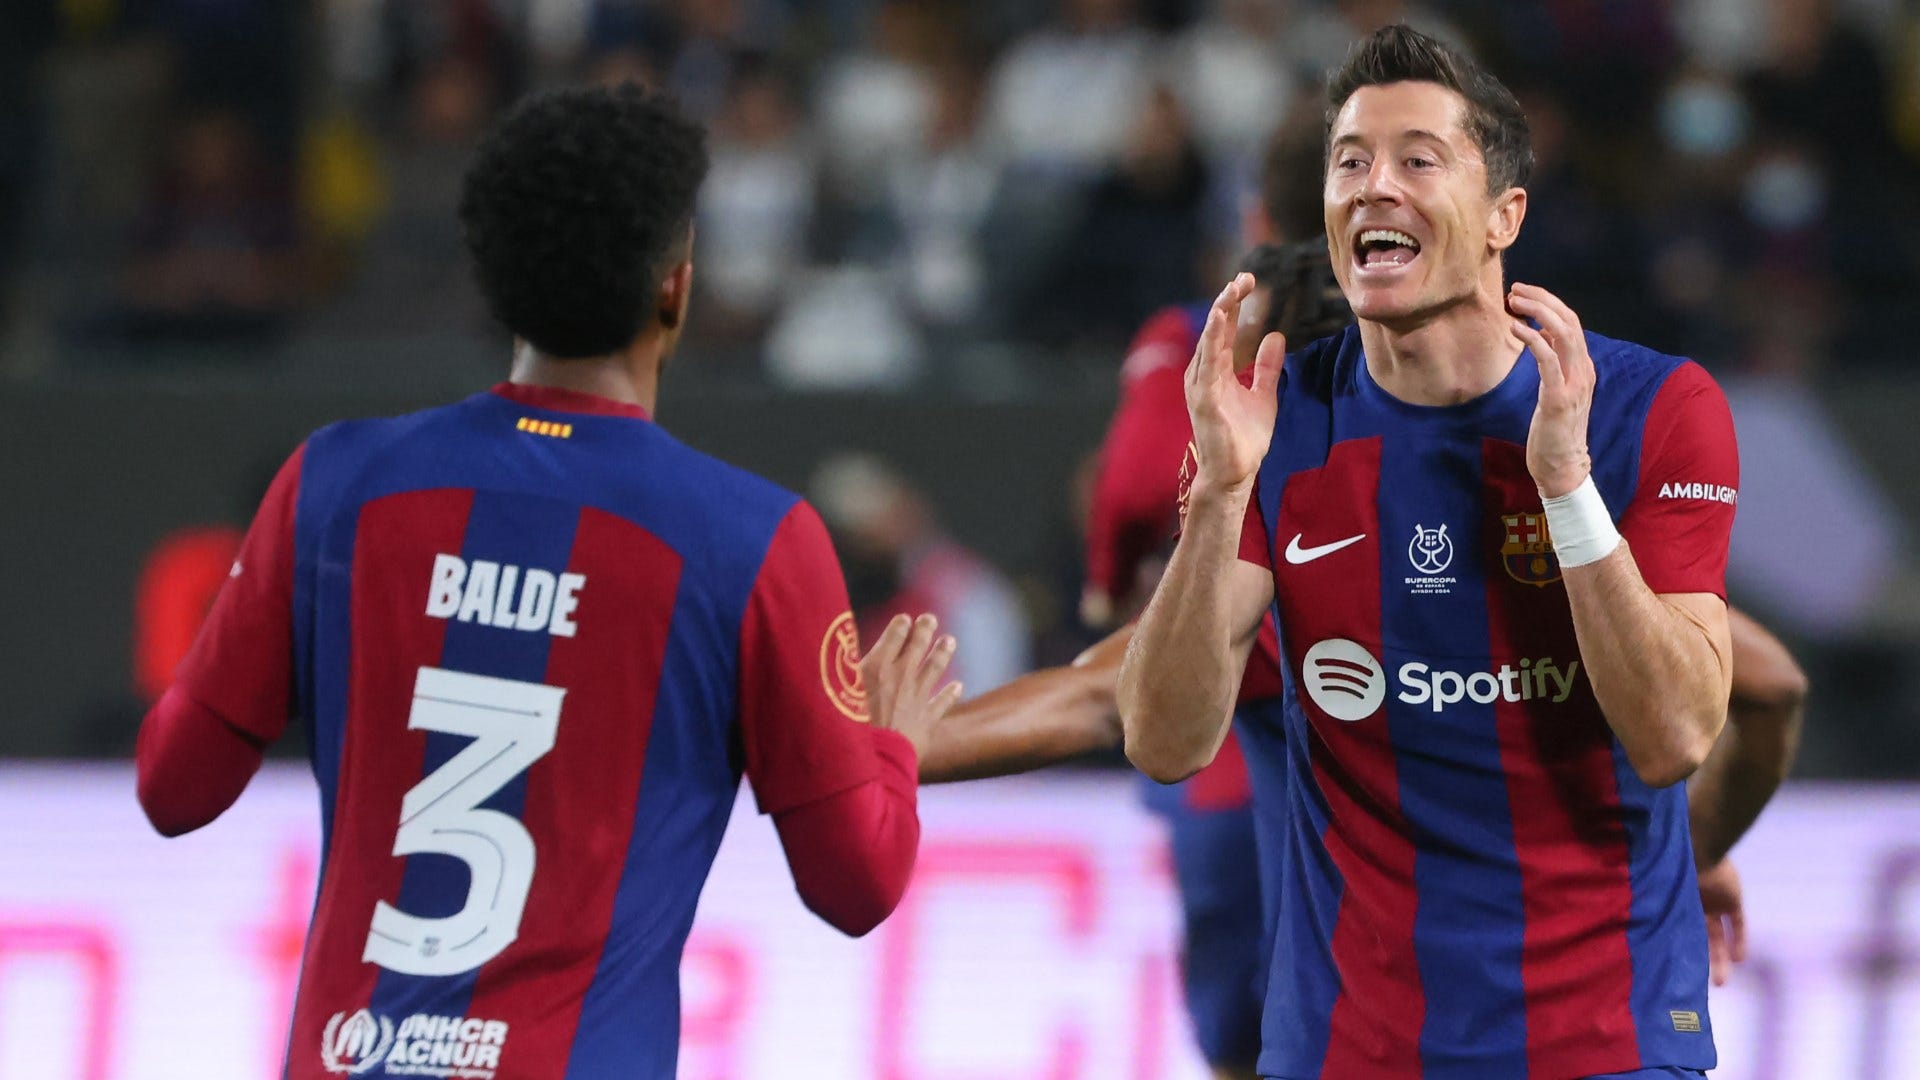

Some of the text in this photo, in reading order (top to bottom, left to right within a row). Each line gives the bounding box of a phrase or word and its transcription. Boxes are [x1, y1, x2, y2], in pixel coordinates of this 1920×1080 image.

[1658, 482, 1736, 505] AMBILIGHT
[425, 553, 587, 638] BALDE
[1398, 657, 1578, 712] Spotify
[361, 666, 568, 976] 3
[396, 1013, 509, 1045] UNHCR
[385, 1039, 502, 1069] ACNUR
